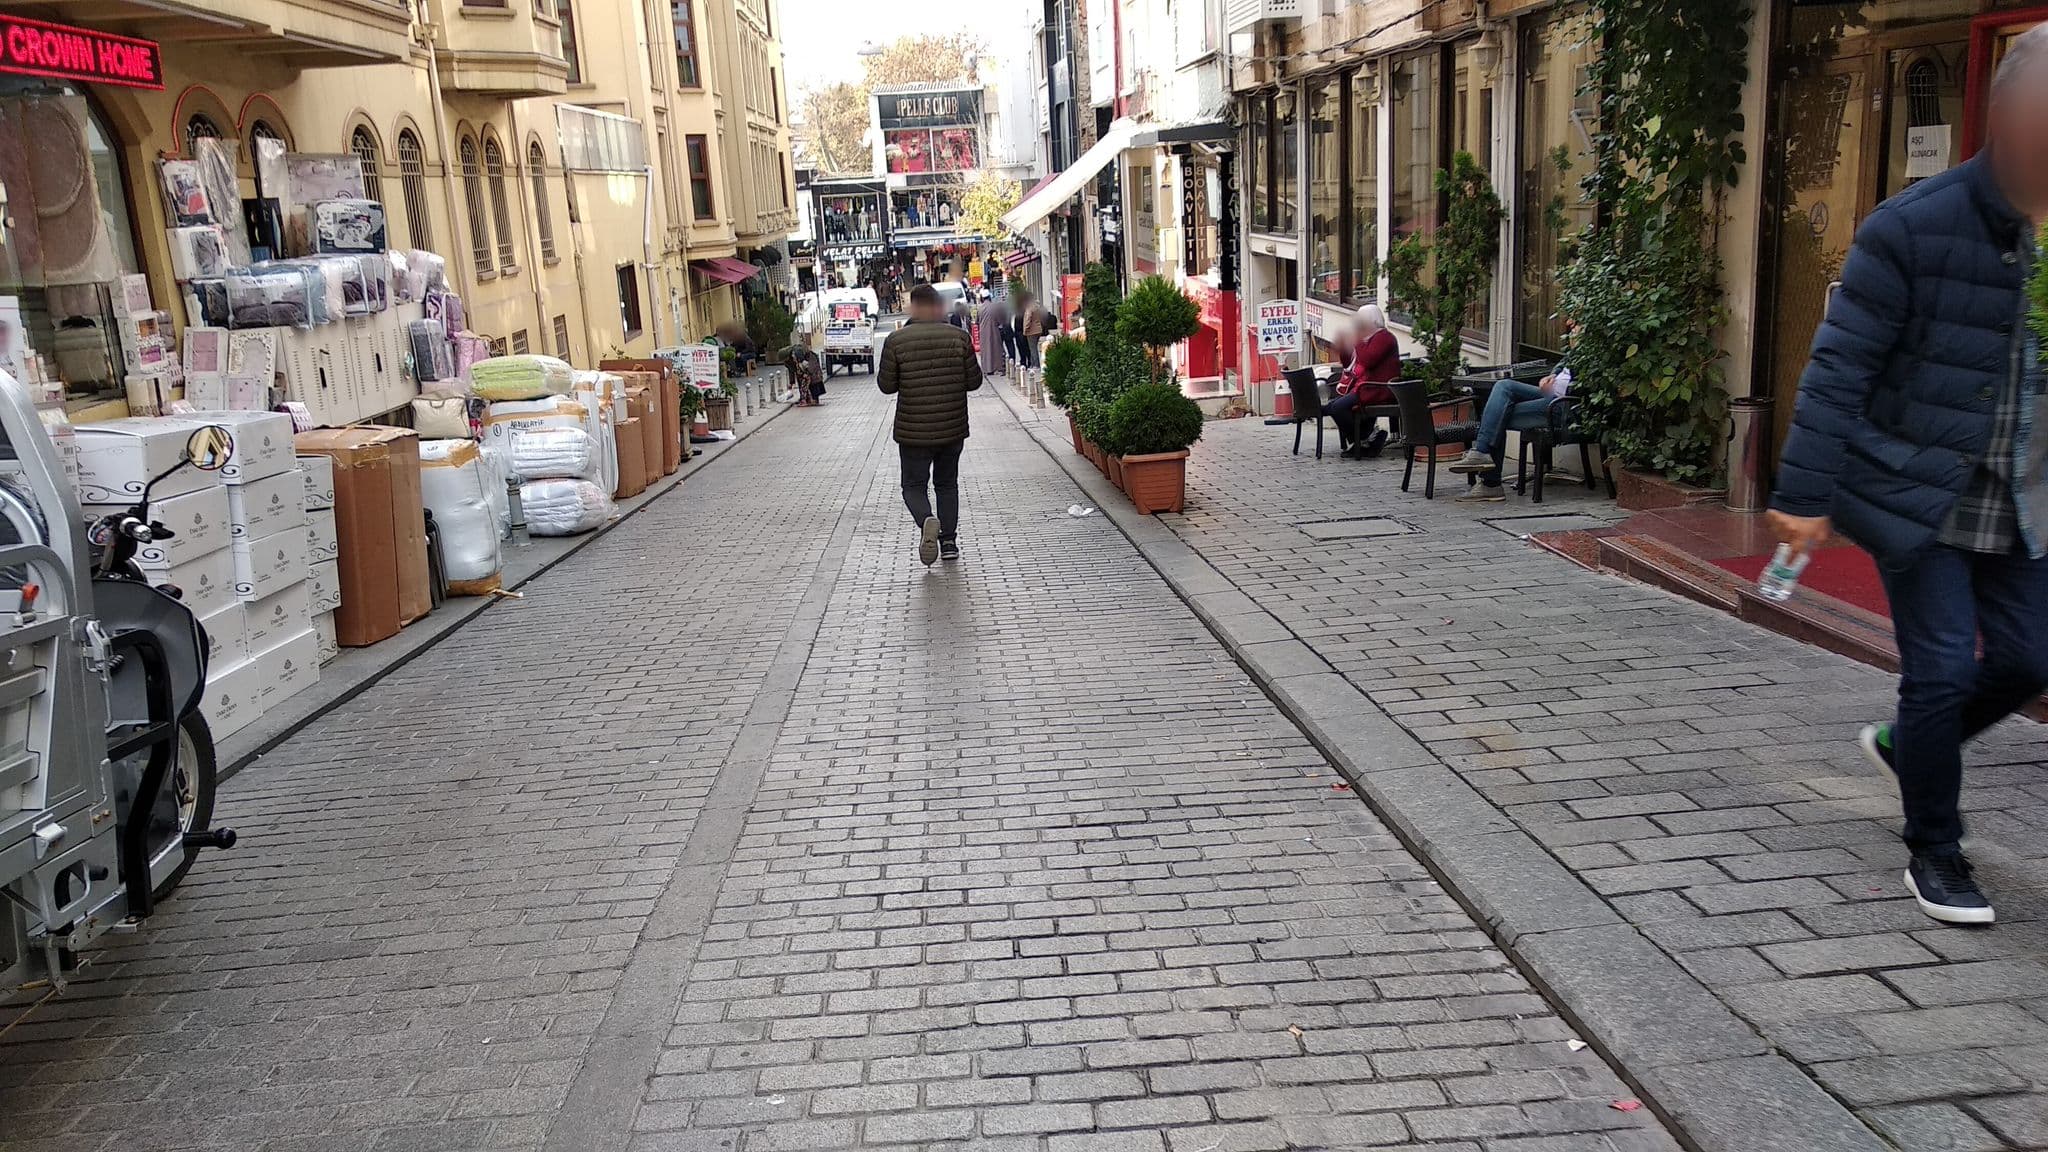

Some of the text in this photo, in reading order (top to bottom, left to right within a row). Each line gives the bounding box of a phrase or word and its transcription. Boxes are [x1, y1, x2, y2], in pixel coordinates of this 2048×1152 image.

[8, 25, 95, 72] CROWN
[97, 39, 154, 80] HOME
[900, 96, 958, 117] PELLE CLUB
[1184, 166, 1194, 261] BOAVITTI
[823, 246, 854, 257] VELAT
[855, 244, 884, 255] PELLE
[1261, 304, 1298, 318] EYFEL
[1267, 316, 1293, 326] ERKEK
